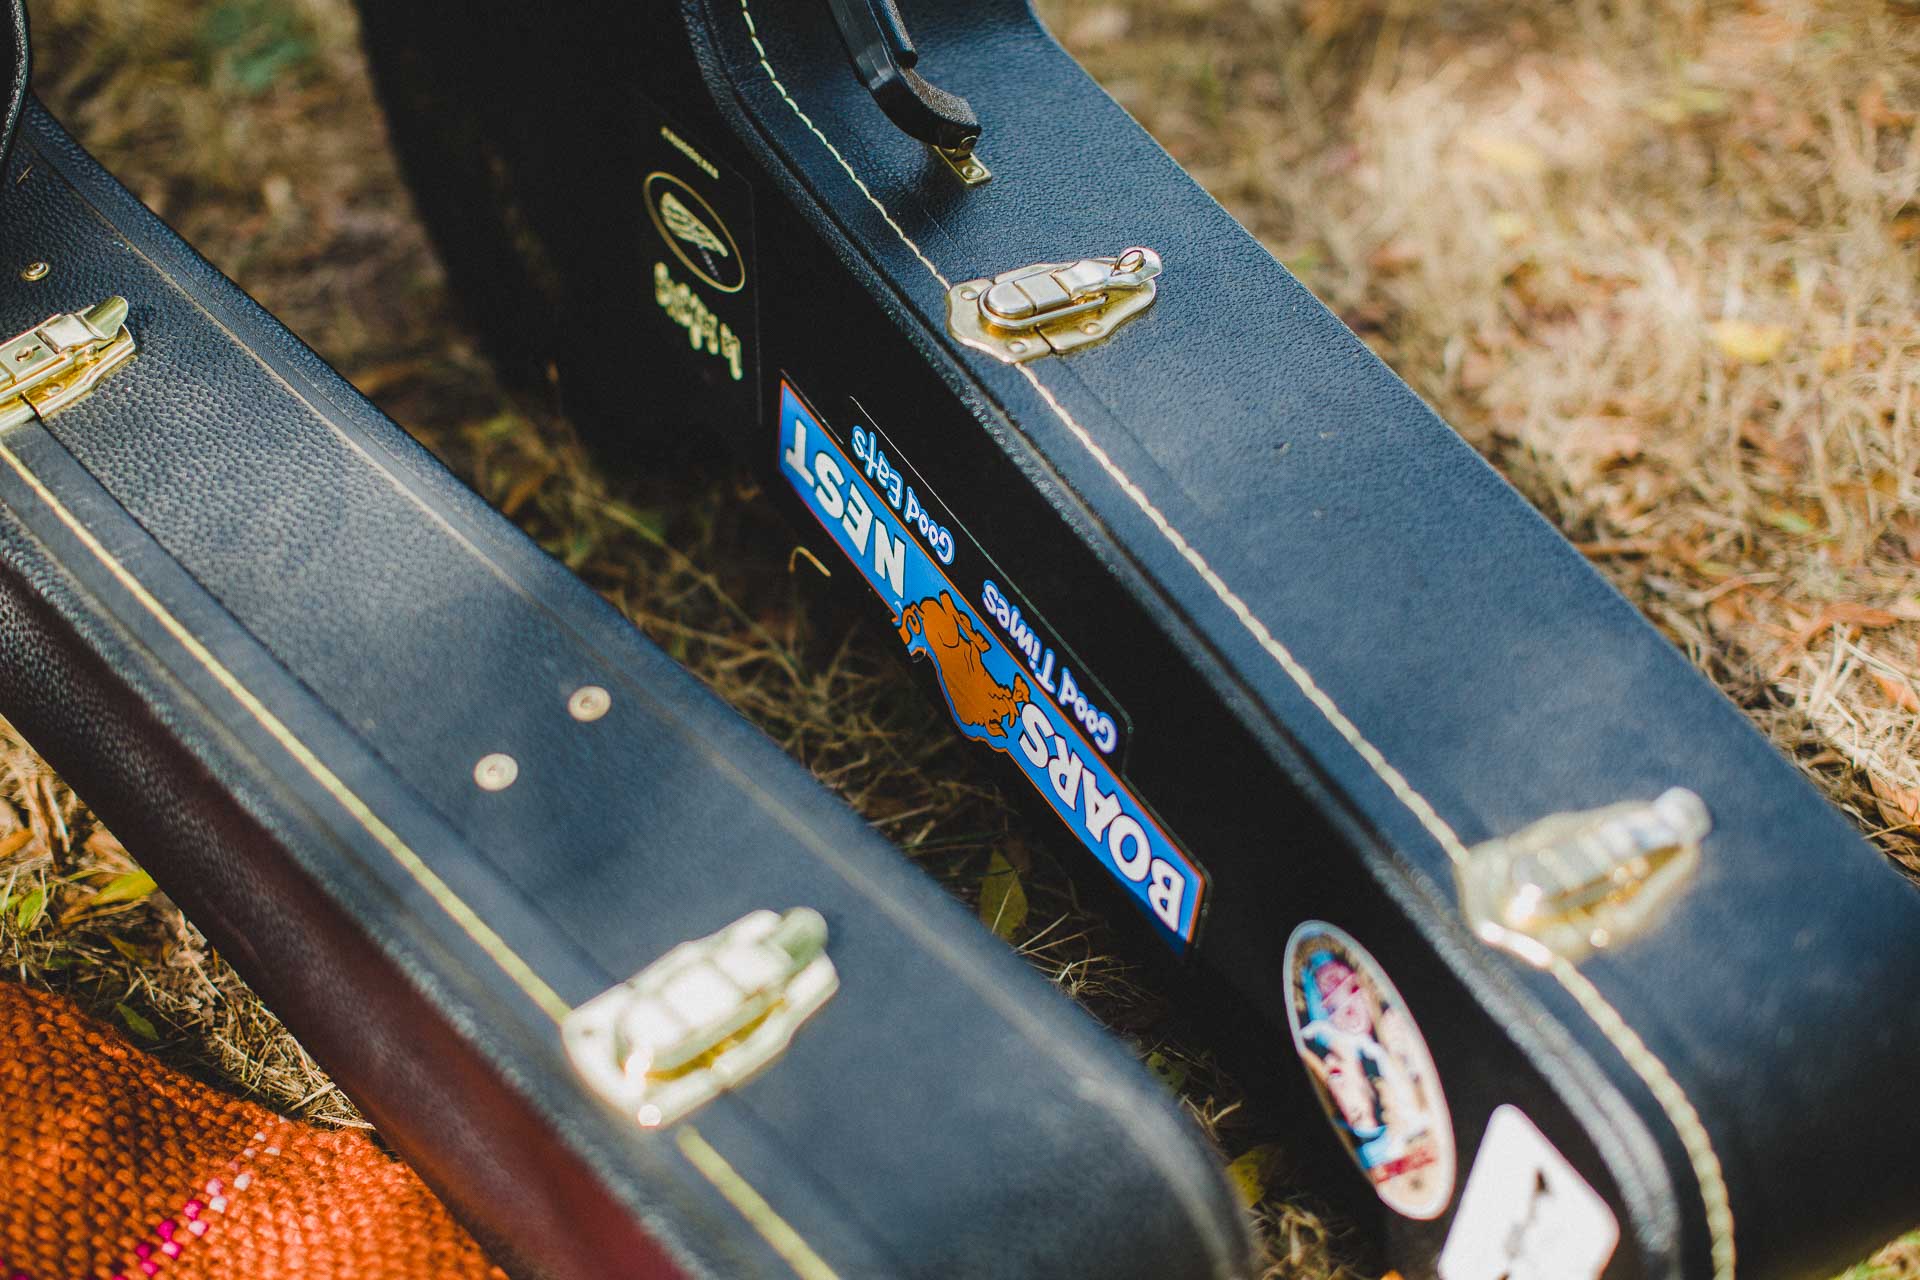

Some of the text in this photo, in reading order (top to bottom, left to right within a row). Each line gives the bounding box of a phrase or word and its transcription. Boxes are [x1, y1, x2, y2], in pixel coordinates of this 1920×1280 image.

[785, 420, 1185, 932] BOARS NEST
[852, 426, 1118, 752] Good Times Good Eats
